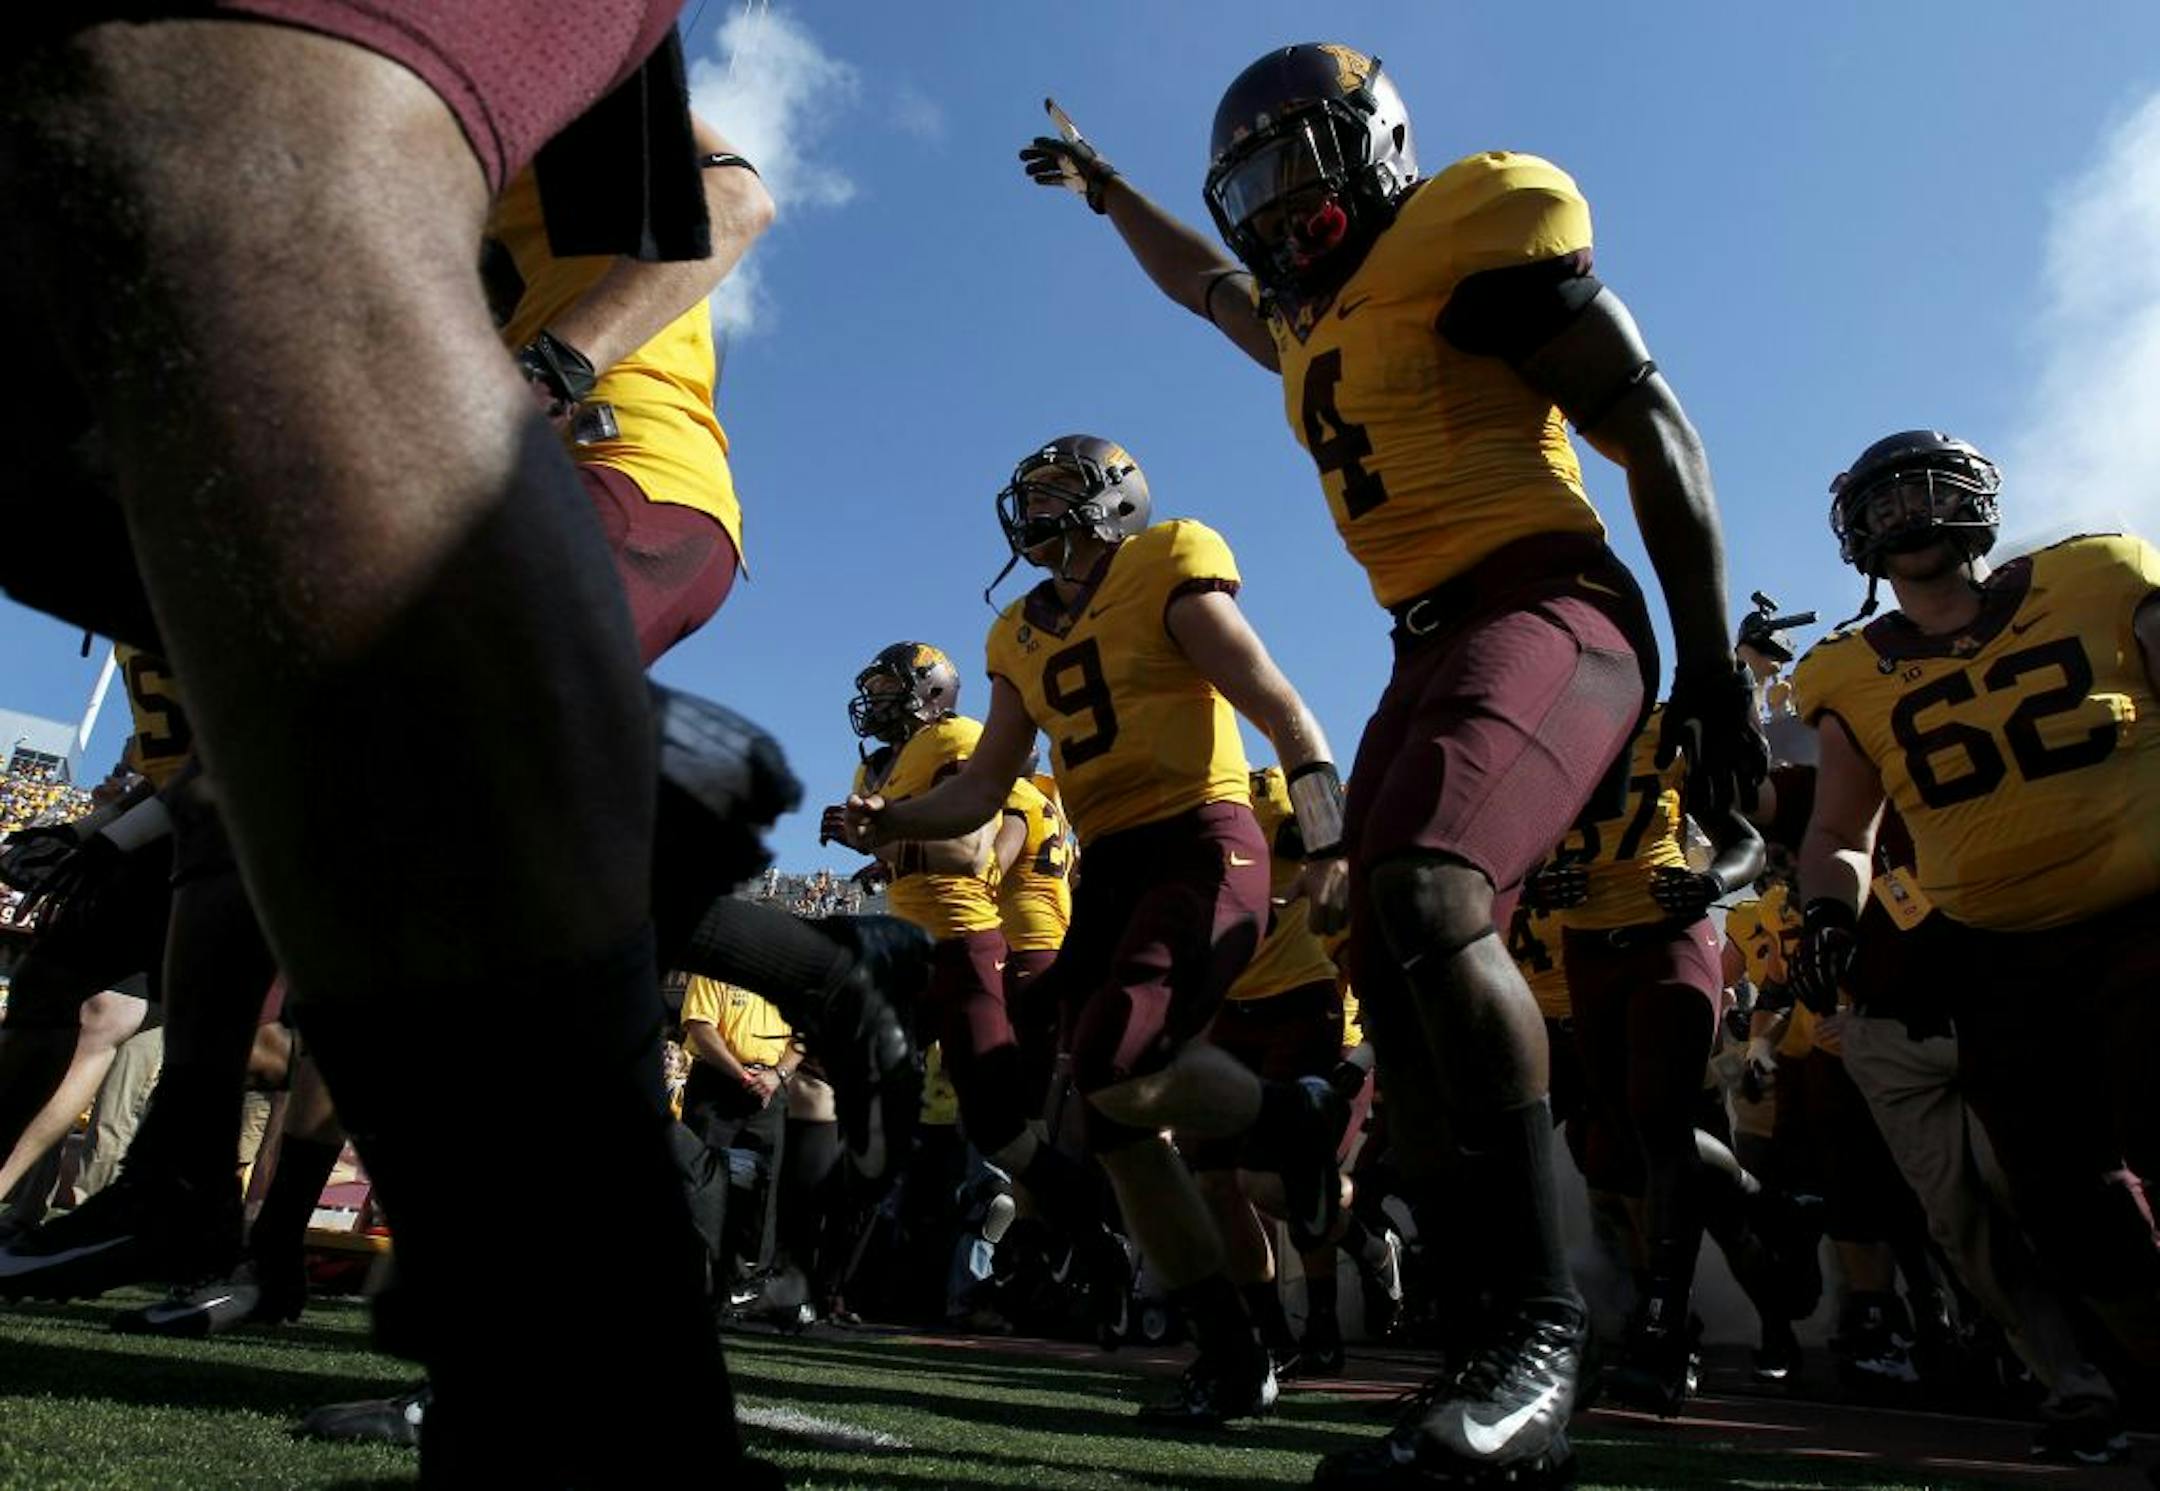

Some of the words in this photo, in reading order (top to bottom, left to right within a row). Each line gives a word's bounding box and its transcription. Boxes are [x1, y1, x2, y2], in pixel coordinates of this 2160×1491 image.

[1303, 349, 1388, 520] 4
[1042, 637, 1117, 769] 9
[1892, 637, 2117, 809] 62
